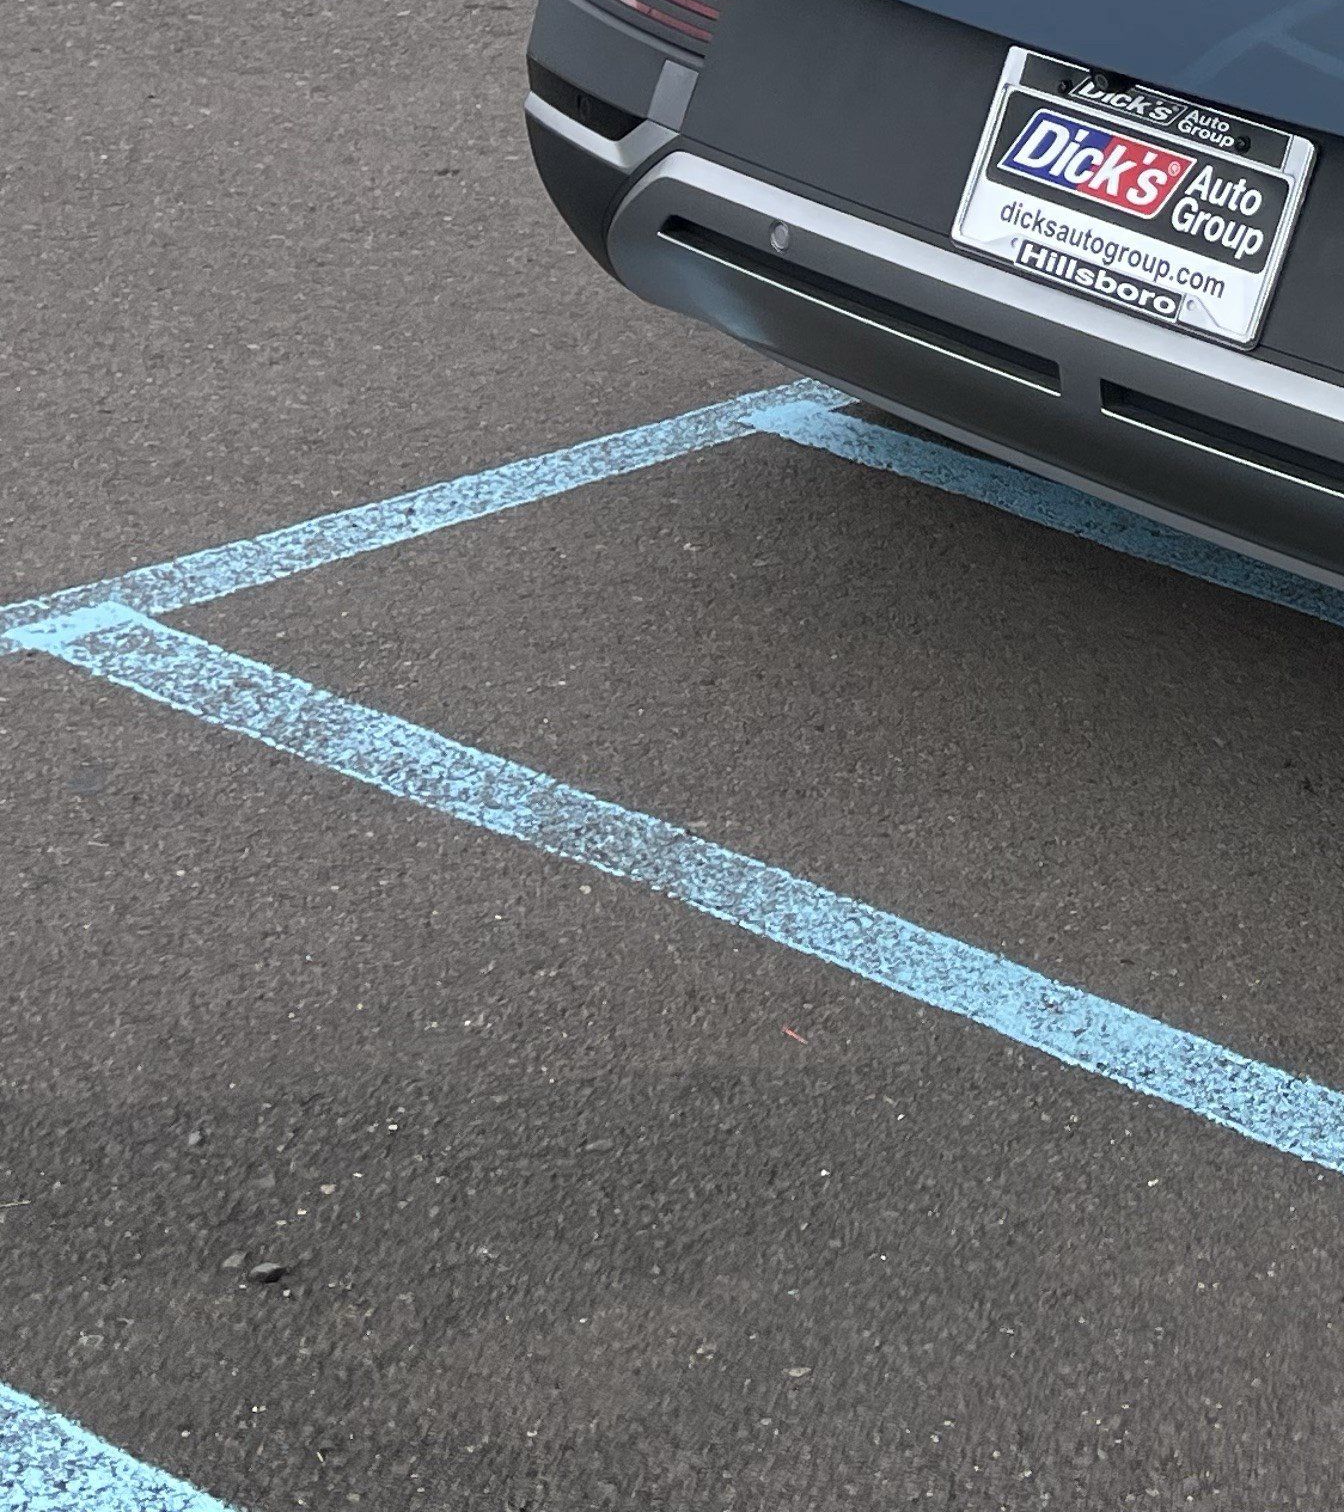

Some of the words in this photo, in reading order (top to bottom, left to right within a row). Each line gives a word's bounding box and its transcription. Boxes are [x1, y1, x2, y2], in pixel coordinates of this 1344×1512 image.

[1177, 117, 1235, 148] Group
[1187, 109, 1230, 133] Auto
[1013, 118, 1168, 206] Dick's
[1184, 165, 1263, 217] Auto
[1000, 200, 1226, 298] dicksautogroup.com
[1172, 197, 1265, 259] Group
[1019, 242, 1178, 315] Hillsboro
